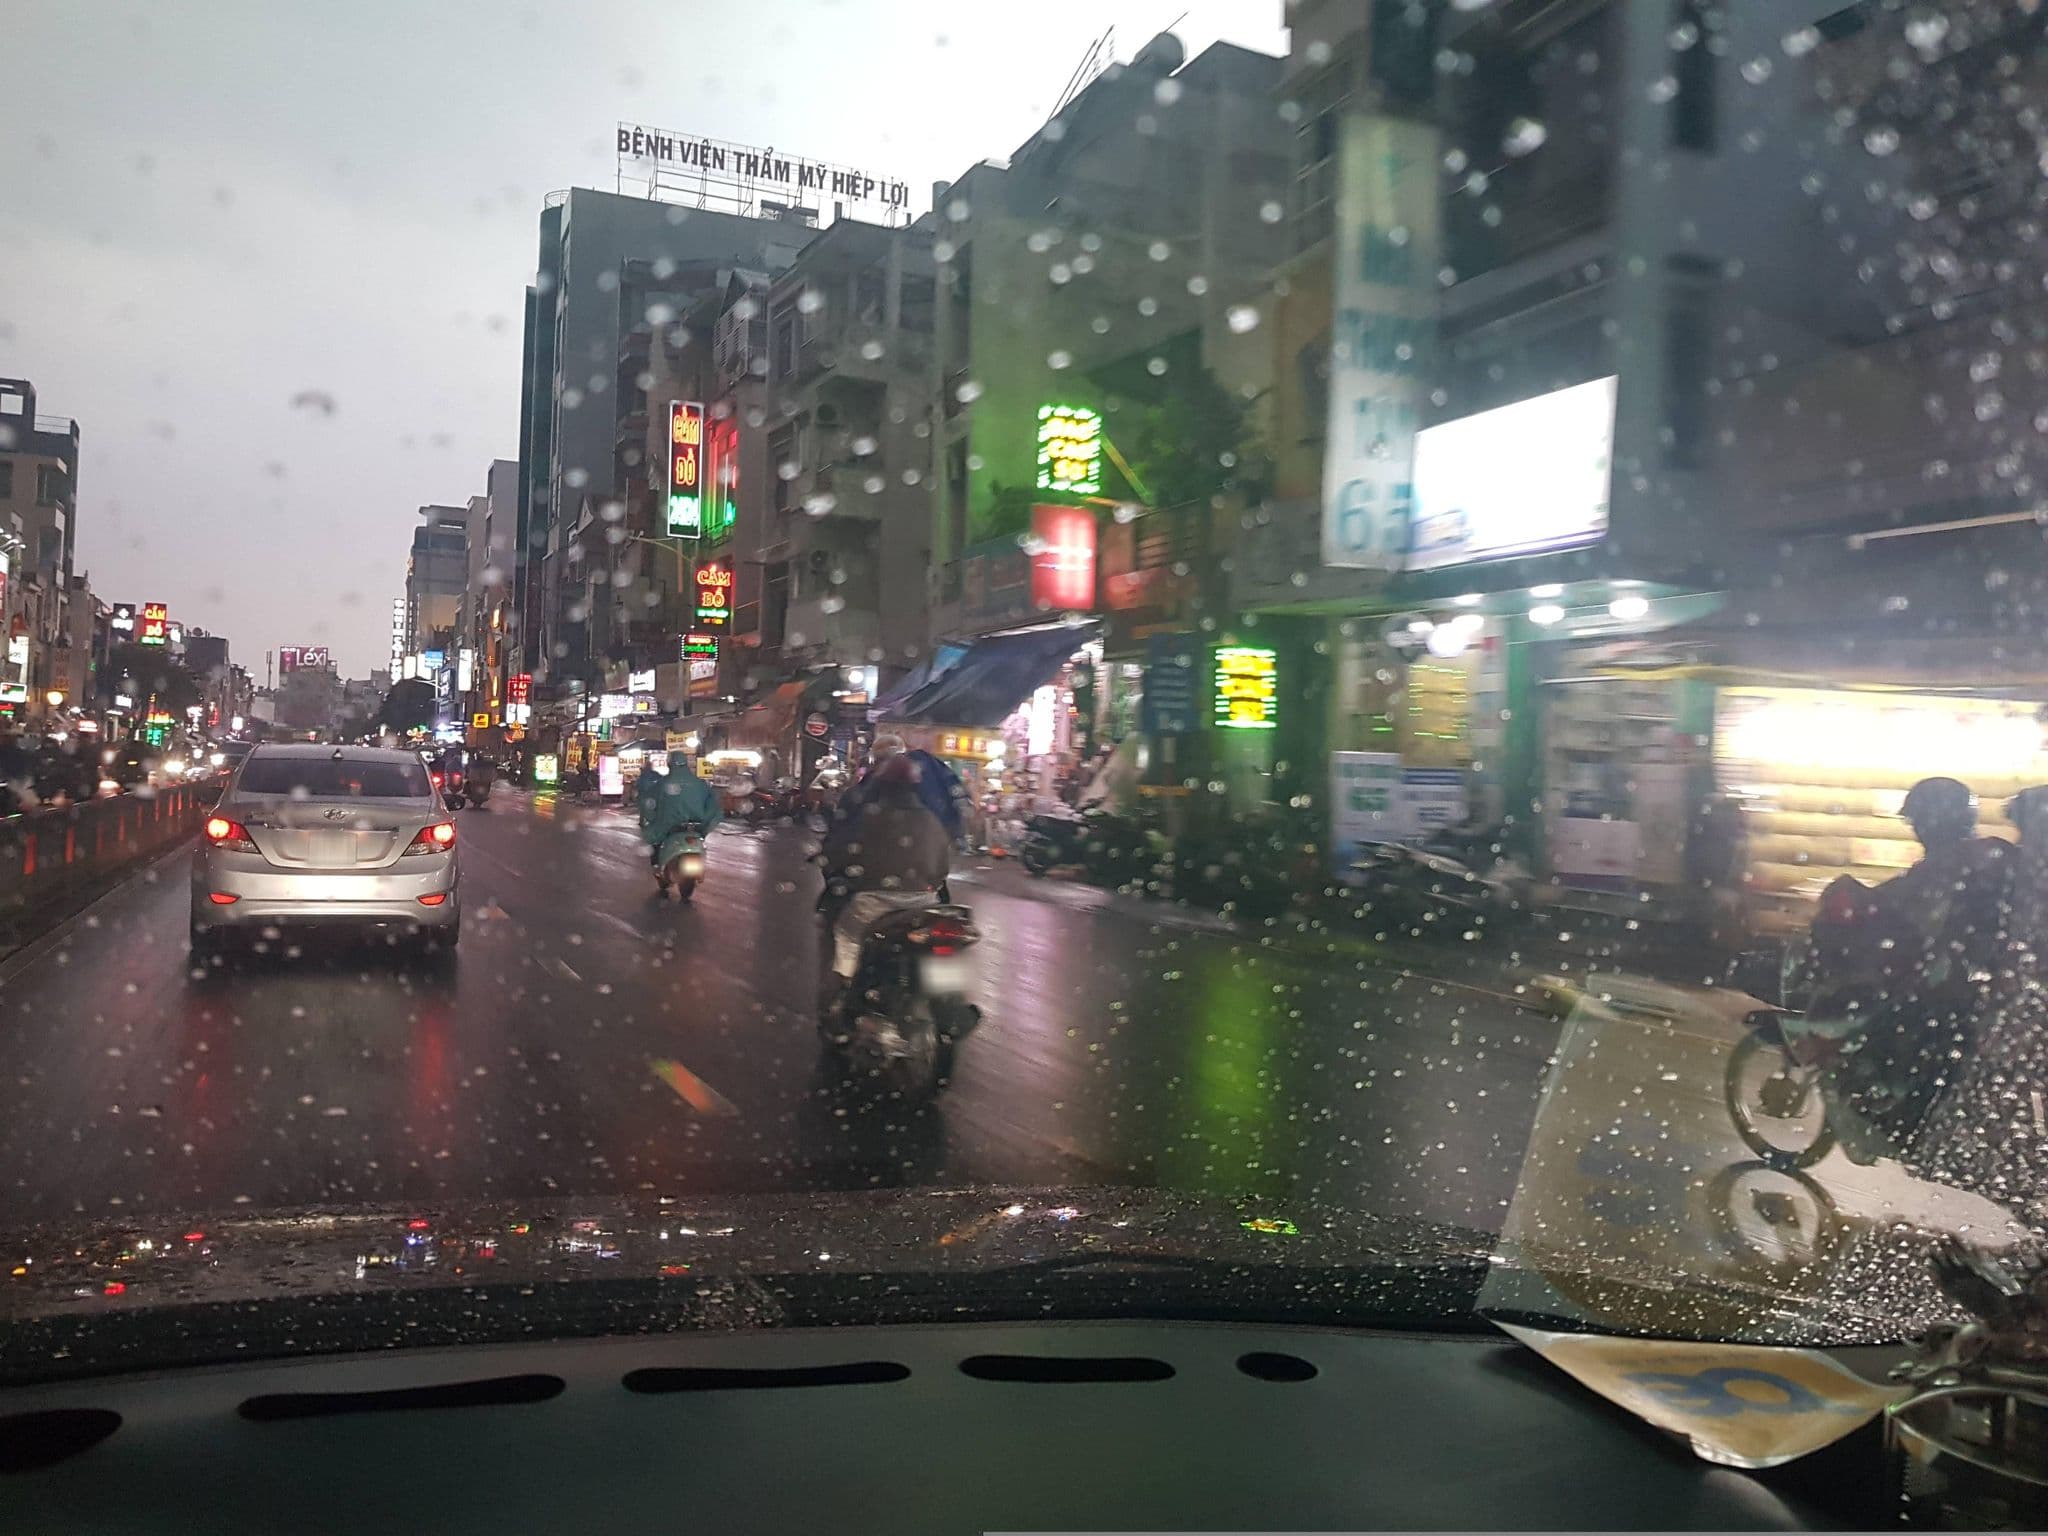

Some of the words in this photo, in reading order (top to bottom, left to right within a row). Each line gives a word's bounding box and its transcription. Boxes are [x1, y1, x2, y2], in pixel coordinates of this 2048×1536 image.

[617, 127, 673, 160] BỆNH
[680, 138, 726, 172] VIỆN
[733, 146, 791, 183] THẨM
[799, 164, 828, 190] MỸ
[832, 171, 875, 201] HIỆP
[880, 180, 909, 210] LỢI
[296, 647, 327, 666] Léxi
